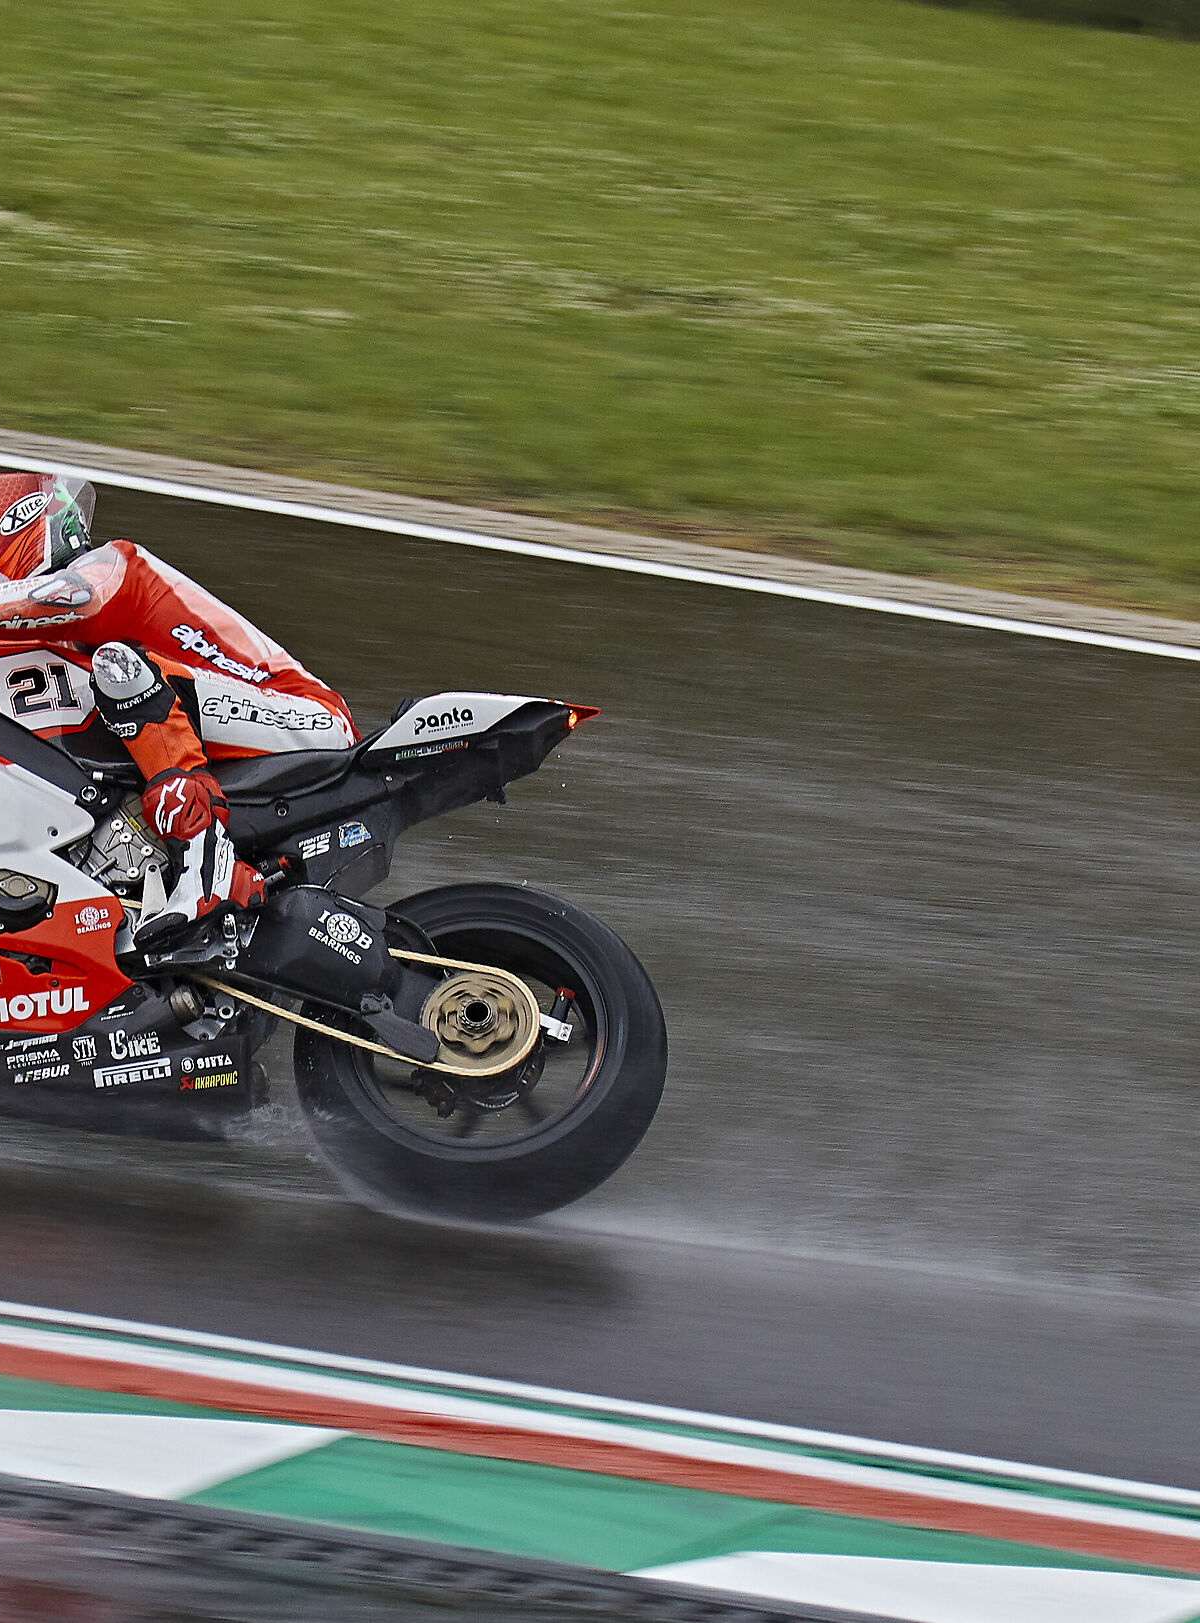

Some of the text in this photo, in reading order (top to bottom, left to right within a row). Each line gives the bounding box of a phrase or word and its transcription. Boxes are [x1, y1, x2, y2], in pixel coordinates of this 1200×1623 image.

[5, 662, 82, 718] 21
[202, 695, 333, 730] alpinestars
[413, 707, 474, 735] panta
[302, 838, 330, 860] 25
[76, 921, 112, 935] BEARINGS
[308, 926, 362, 965] BEARINGS
[6, 1048, 60, 1065] PRISMA
[72, 1037, 98, 1060] STM
[24, 1063, 70, 1083] FEBUR
[92, 1057, 172, 1089] PIRELLI
